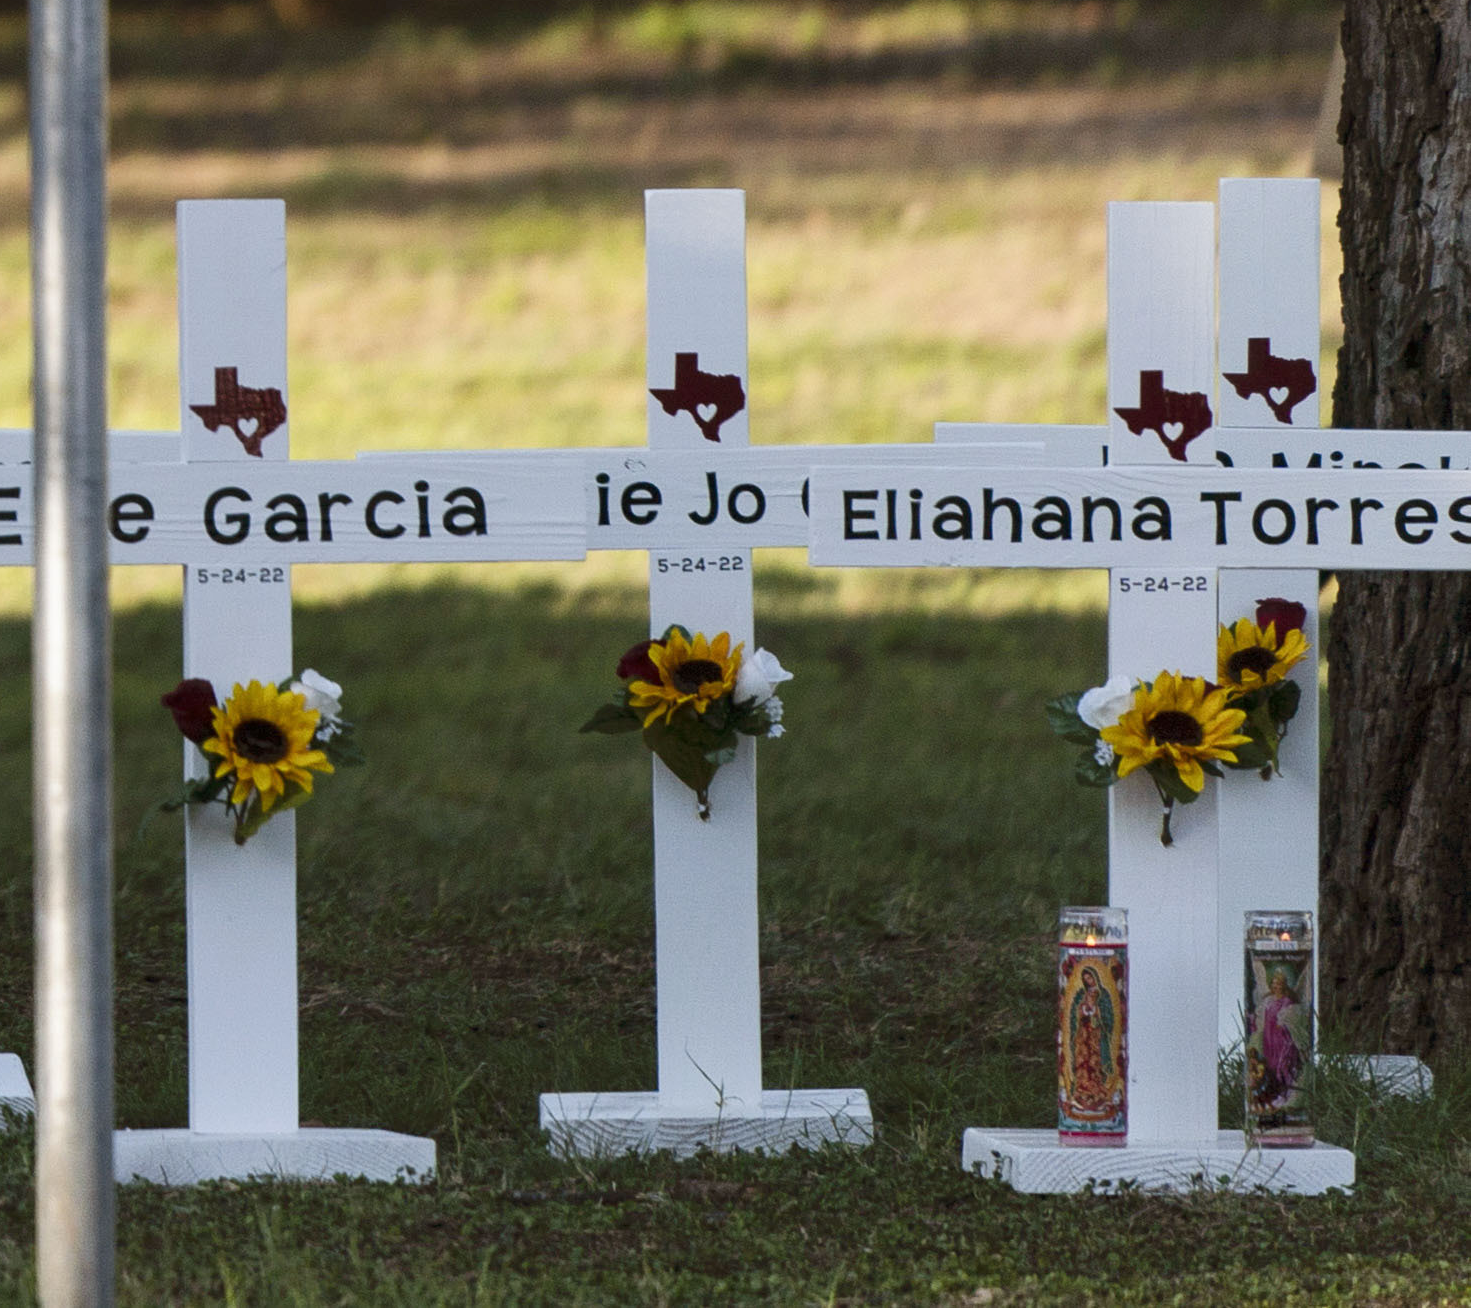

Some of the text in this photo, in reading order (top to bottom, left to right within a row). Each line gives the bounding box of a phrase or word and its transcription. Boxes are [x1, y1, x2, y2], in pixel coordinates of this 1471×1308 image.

[203, 480, 488, 546] Garcia
[688, 471, 767, 526] Jo
[843, 487, 1173, 542] Eliahana
[1200, 489, 1471, 546] Torres
[198, 567, 285, 584] 5-24-22
[657, 555, 744, 574] 5-24-22
[1119, 573, 1208, 594] 5-24-22
